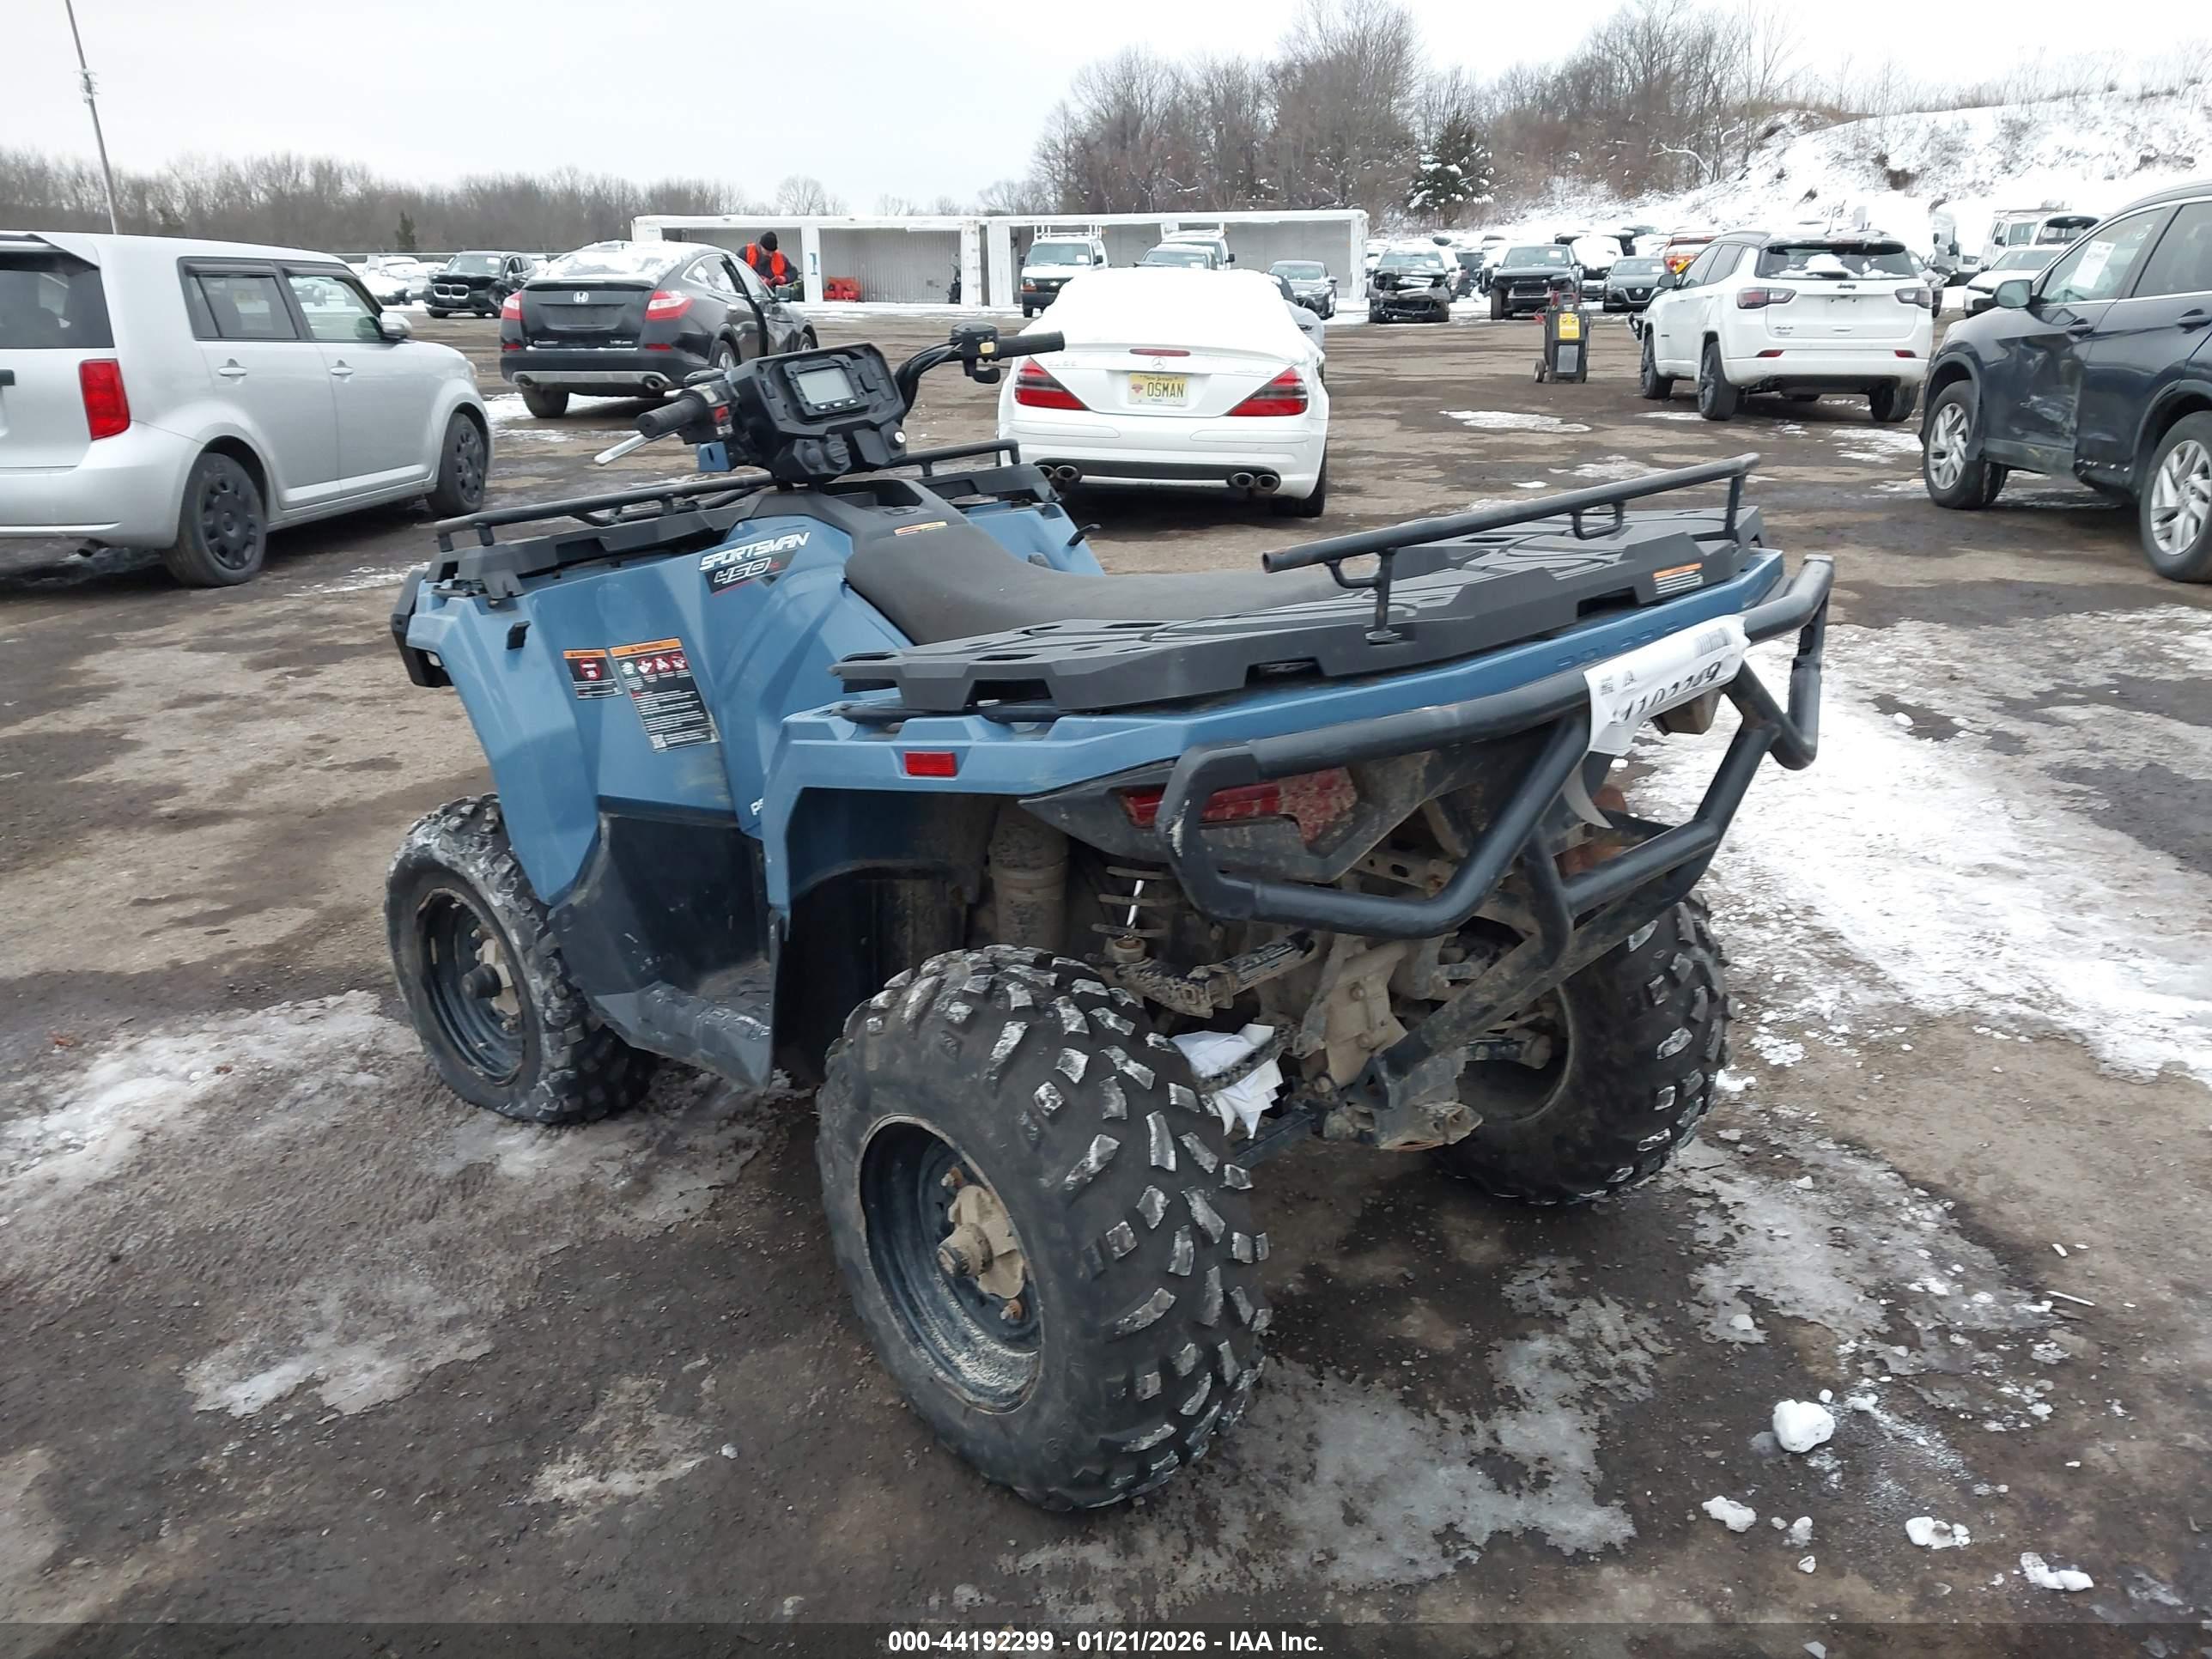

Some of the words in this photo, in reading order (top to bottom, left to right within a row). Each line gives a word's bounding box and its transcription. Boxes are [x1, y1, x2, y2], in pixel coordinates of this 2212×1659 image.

[1147, 382, 1184, 398] OSMAN
[699, 532, 811, 571] SPORTSMAN
[713, 556, 772, 585] 450
